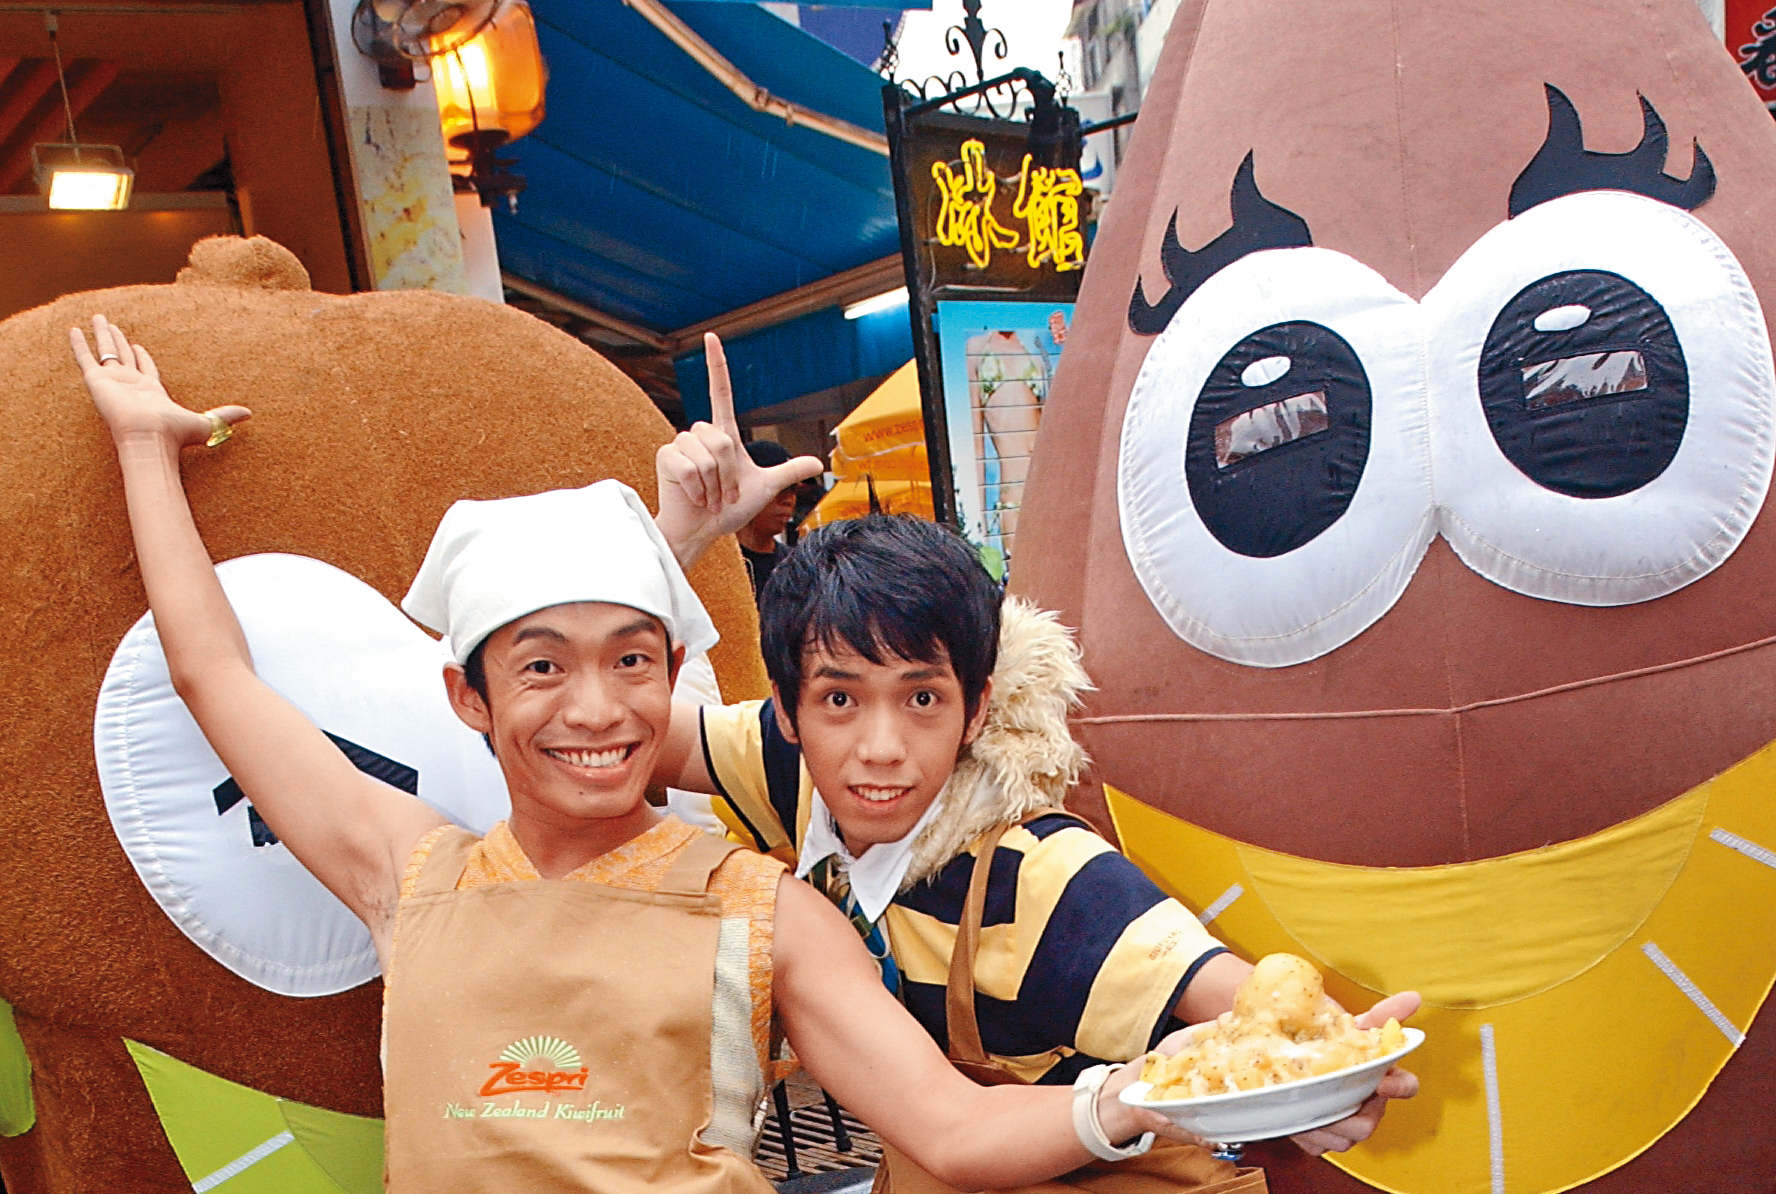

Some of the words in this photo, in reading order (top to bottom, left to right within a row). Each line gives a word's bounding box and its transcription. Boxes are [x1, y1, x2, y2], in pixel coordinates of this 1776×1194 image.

[479, 1061, 589, 1097] Zespri
[443, 1102, 477, 1119] New
[480, 1100, 551, 1119] Zealand
[553, 1101, 626, 1123] Kiwifruit
